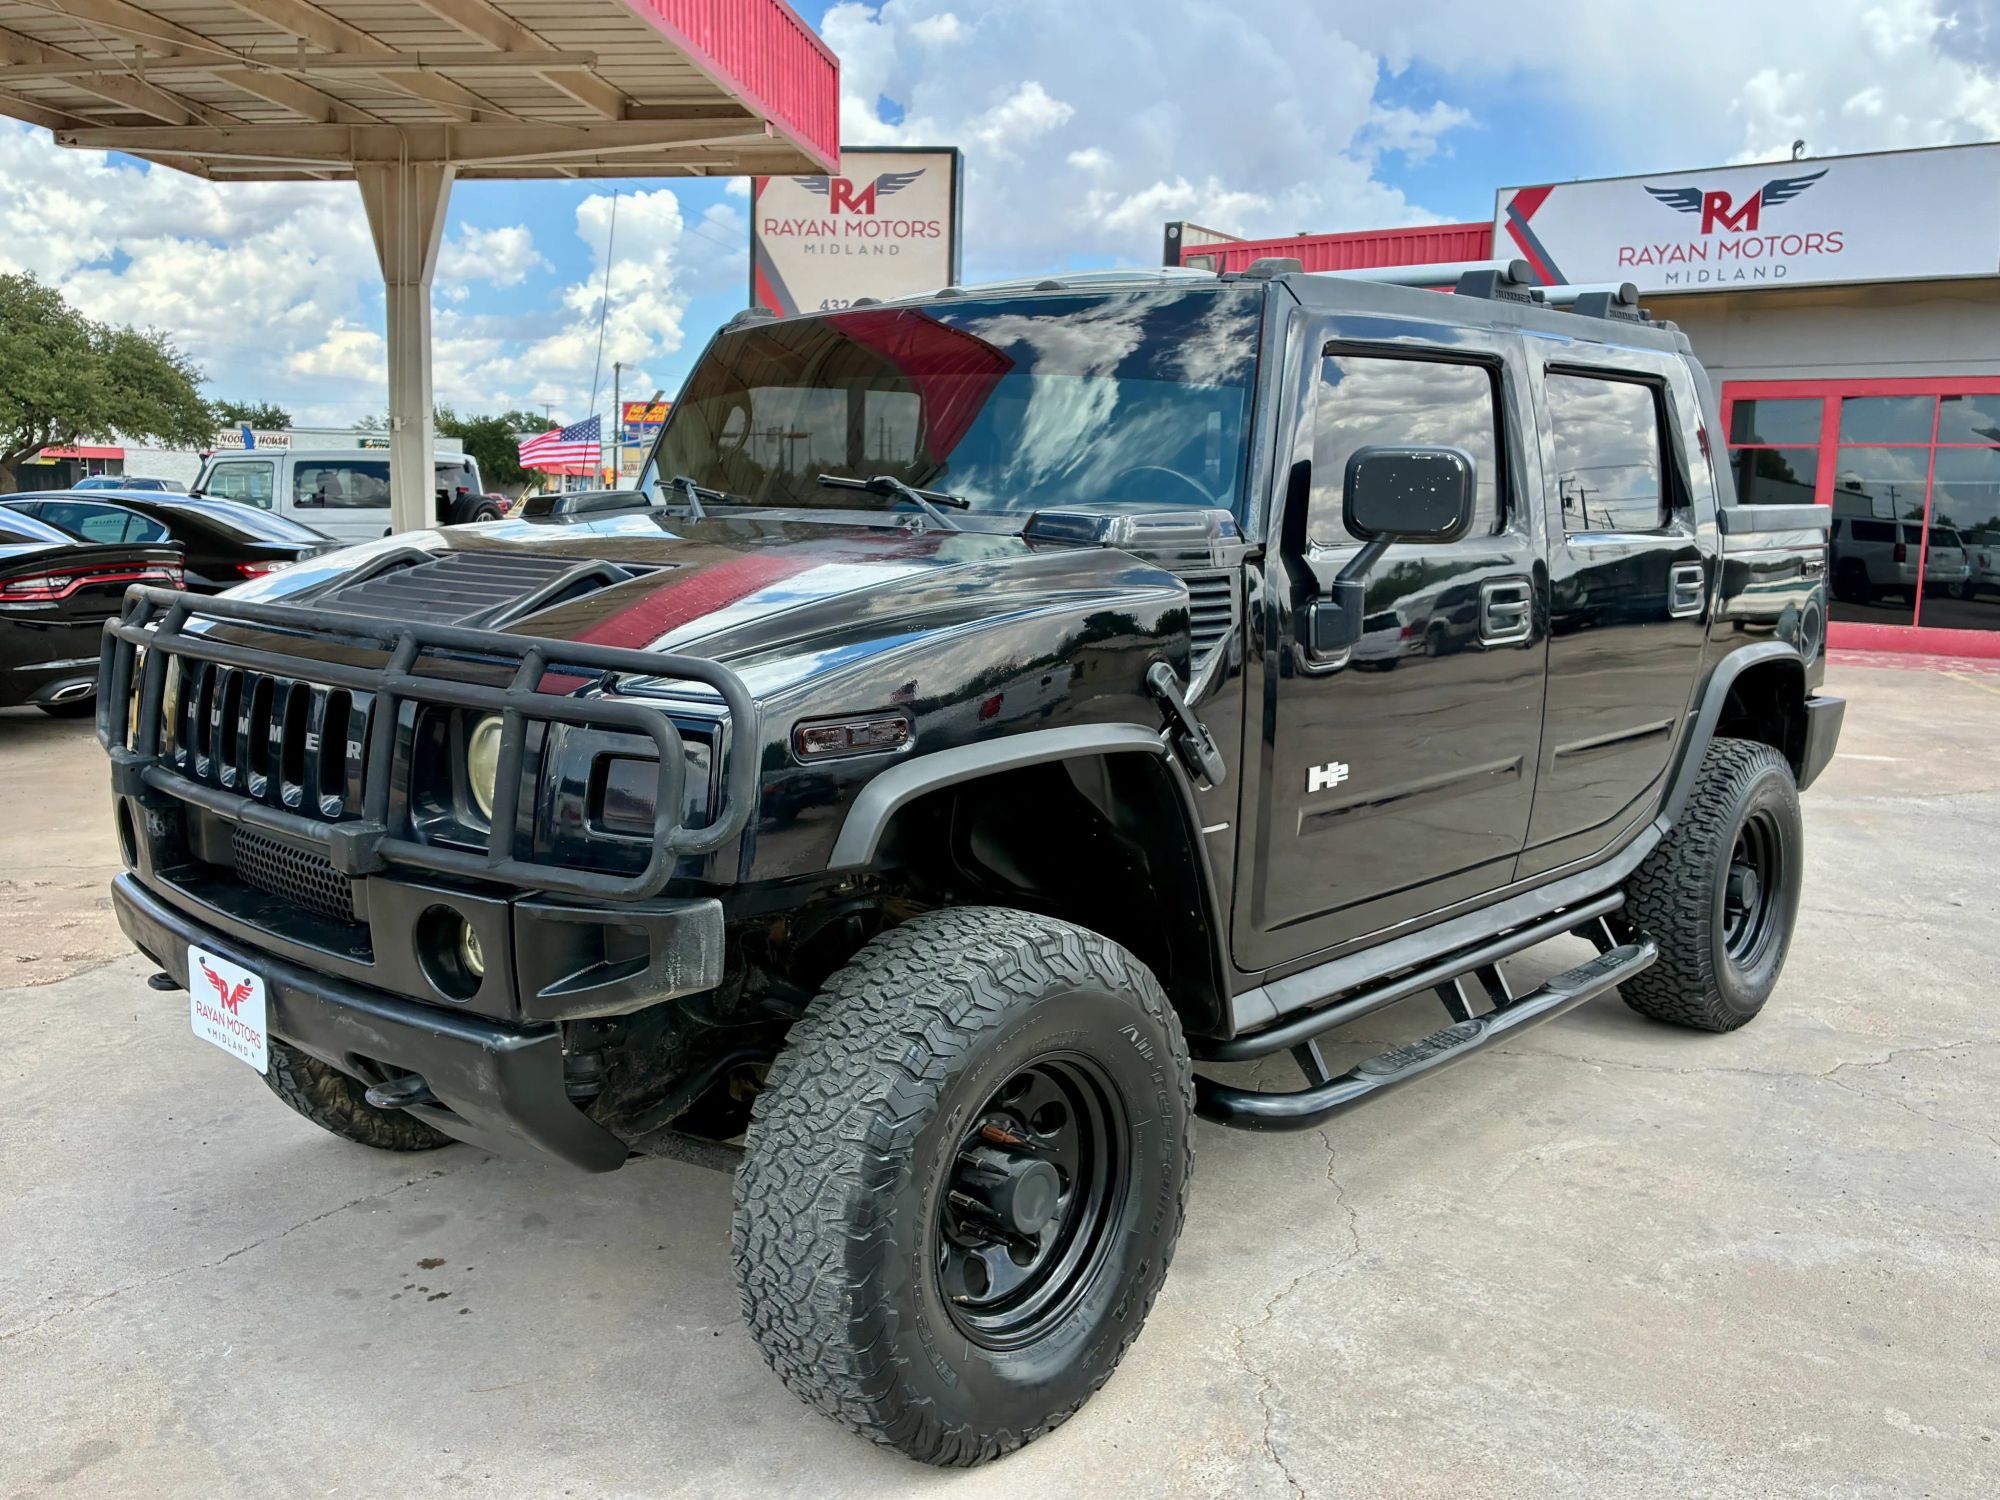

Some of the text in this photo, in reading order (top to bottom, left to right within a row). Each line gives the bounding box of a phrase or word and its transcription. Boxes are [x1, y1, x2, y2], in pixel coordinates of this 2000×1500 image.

[764, 219, 940, 239] RAYAN MOTORS
[804, 244, 899, 256] MIDLAND
[1618, 231, 1844, 267] RAYAN MOTORS
[1665, 265, 1787, 285] MIDLAND
[258, 437, 289, 445] HOUSE
[188, 701, 362, 760] HUMMER
[1306, 761, 1349, 793] H2
[196, 1000, 262, 1050] RAYAN MOTORS
[212, 1029, 249, 1057] MIDLAND
